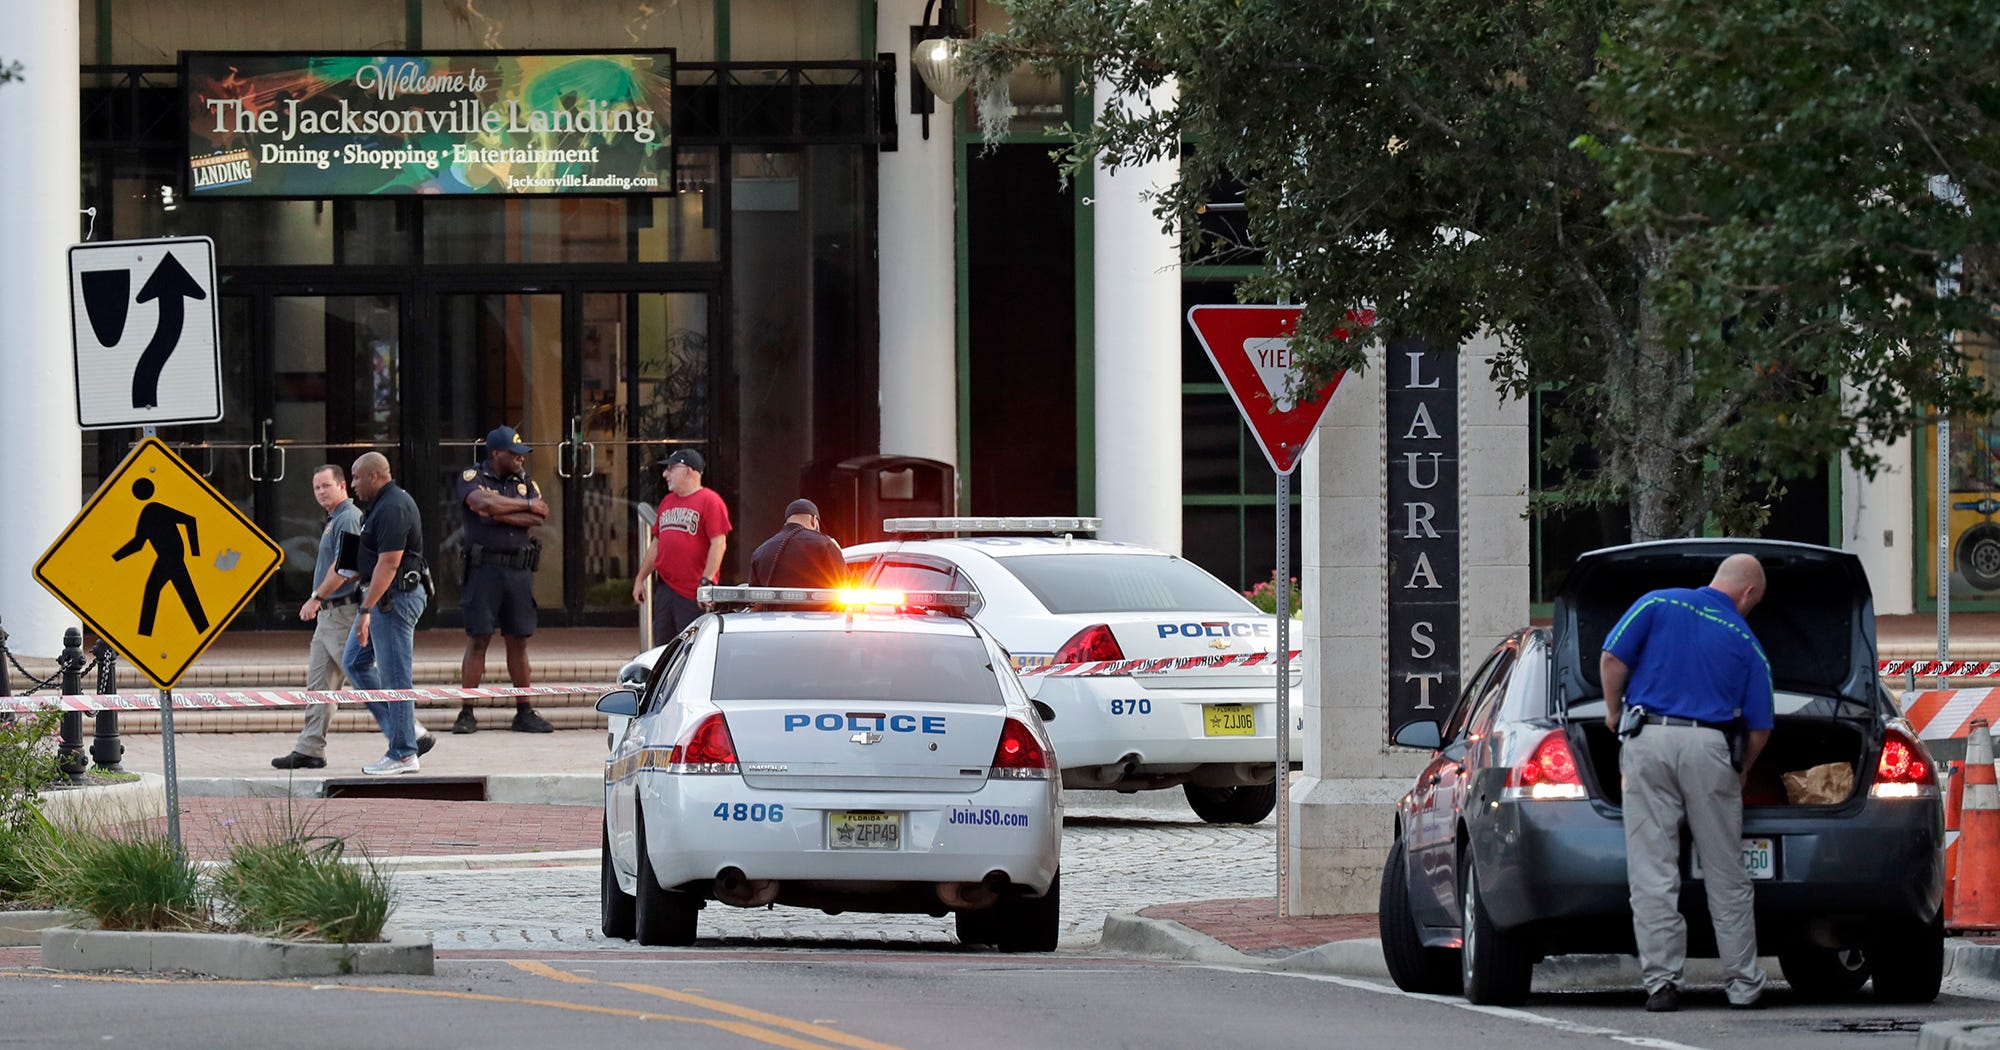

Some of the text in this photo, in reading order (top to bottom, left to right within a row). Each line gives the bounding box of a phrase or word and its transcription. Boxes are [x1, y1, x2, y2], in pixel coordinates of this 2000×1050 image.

[356, 61, 488, 100] Welcome to
[207, 98, 656, 143] The Jacksonville Landing
[260, 143, 600, 170] Dining Shopping Entertainment
[192, 160, 252, 187] LANDING
[507, 174, 658, 190] JacksonvilleLanding.com
[1403, 351, 1442, 710] LAURA ST
[1157, 622, 1271, 639] POLICE
[1103, 660, 1135, 672] POLICE
[1138, 658, 1159, 671] LINE
[1175, 657, 1192, 668] NOT
[1196, 654, 1225, 666] CROSS
[1110, 698, 1152, 715] 870
[784, 713, 946, 735] POLICE
[1224, 714, 1253, 729] ZJJ06
[748, 763, 788, 773] IMPALA
[713, 802, 785, 823] 4806
[848, 814, 881, 822] FLORIDA
[949, 808, 1029, 827] JoinJSO.com
[856, 823, 898, 842] ZFP49
